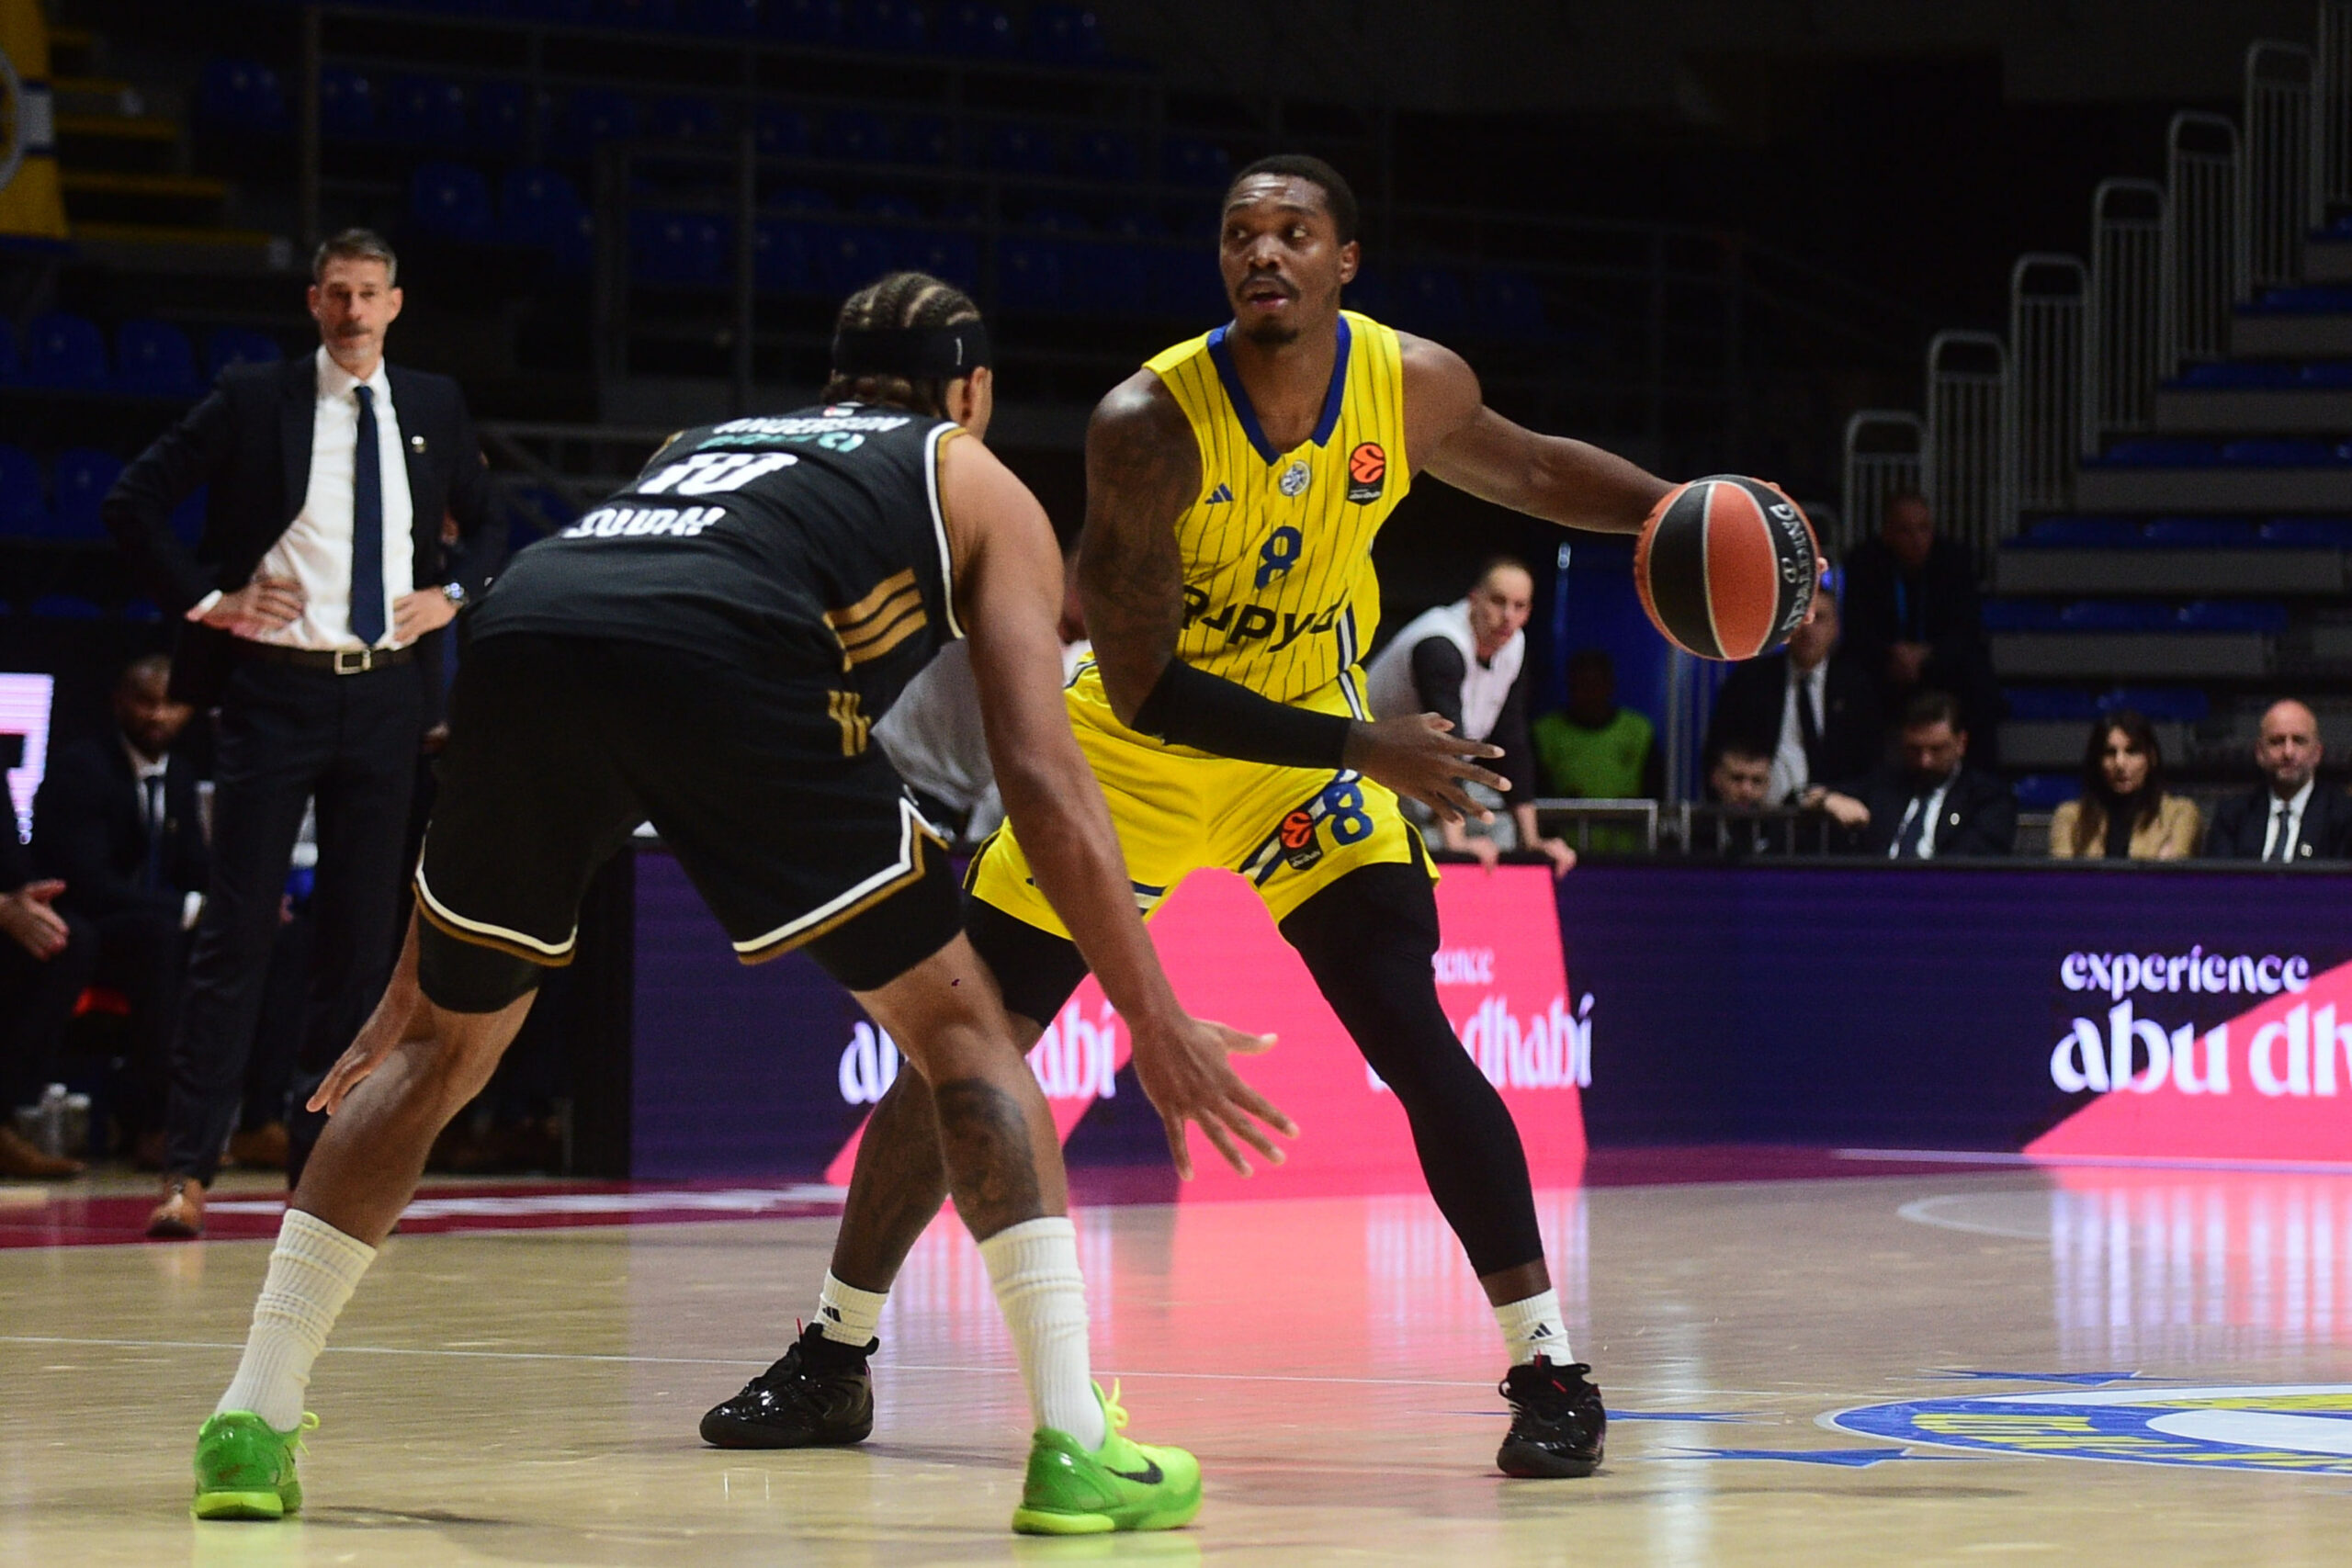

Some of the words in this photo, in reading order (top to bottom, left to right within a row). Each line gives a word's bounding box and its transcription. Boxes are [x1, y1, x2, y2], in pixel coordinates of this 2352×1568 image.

[1255, 526, 1302, 590] 8
[1323, 783, 1374, 845] 8
[2061, 944, 2310, 1000] experience
[2050, 998, 2231, 1093] abu
